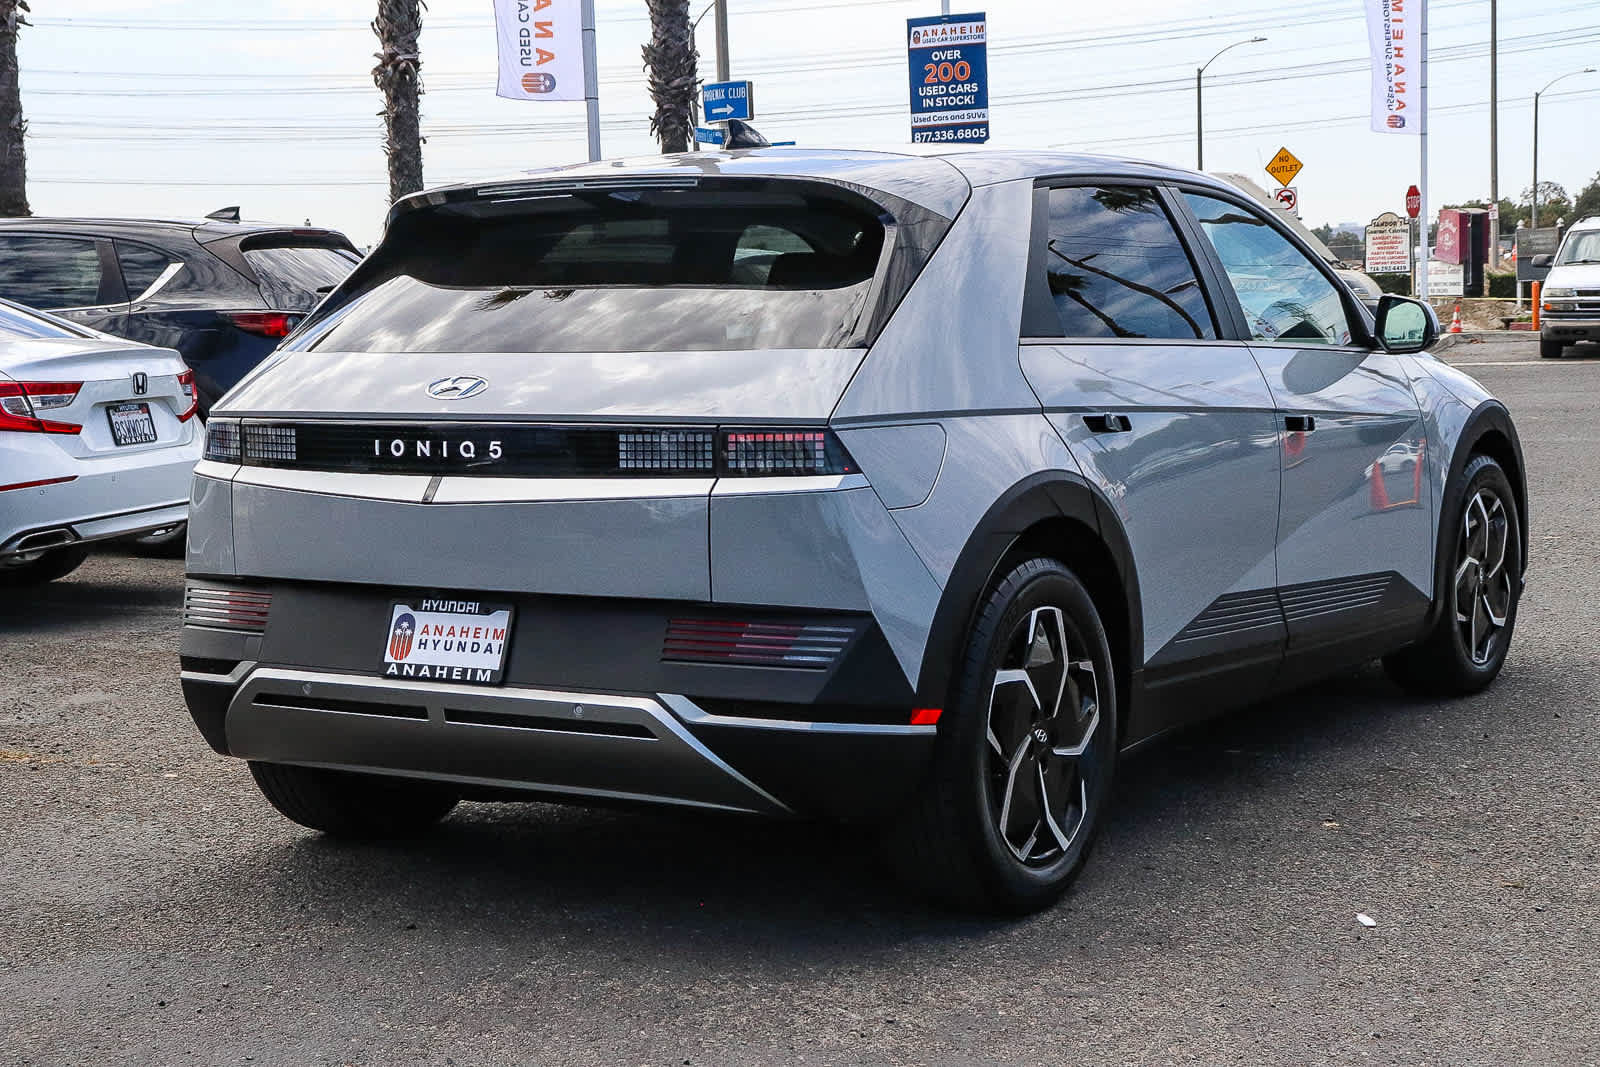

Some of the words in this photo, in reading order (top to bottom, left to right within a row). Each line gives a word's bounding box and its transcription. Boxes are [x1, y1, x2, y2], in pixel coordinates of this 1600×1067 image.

[922, 25, 985, 38] ANAHEIM
[949, 33, 985, 41] SUPERSTORE
[931, 49, 962, 61] OVER
[924, 61, 971, 84] 200
[703, 88, 726, 102] PHOENIX
[728, 87, 746, 99] CLUB
[918, 85, 947, 96] USED
[948, 83, 979, 94] CARS
[922, 98, 934, 108] IN
[935, 95, 975, 107] STOCK!
[913, 115, 932, 123] Used
[932, 114, 949, 122] Cars
[949, 113, 965, 121] and
[966, 111, 986, 120] SUVs
[914, 128, 987, 143] 877.336.6805
[1279, 155, 1290, 163] NO
[1271, 164, 1298, 174] OUTLET
[1407, 195, 1421, 209] STOP
[121, 436, 154, 445] ANAHEIM
[374, 439, 475, 458] IONIQ
[489, 441, 502, 459] 5
[421, 599, 480, 614] HYUNDAI
[420, 624, 505, 641] ANAHEIM
[418, 638, 503, 655] HYUNDAI
[386, 662, 492, 682] ANAHEIM
